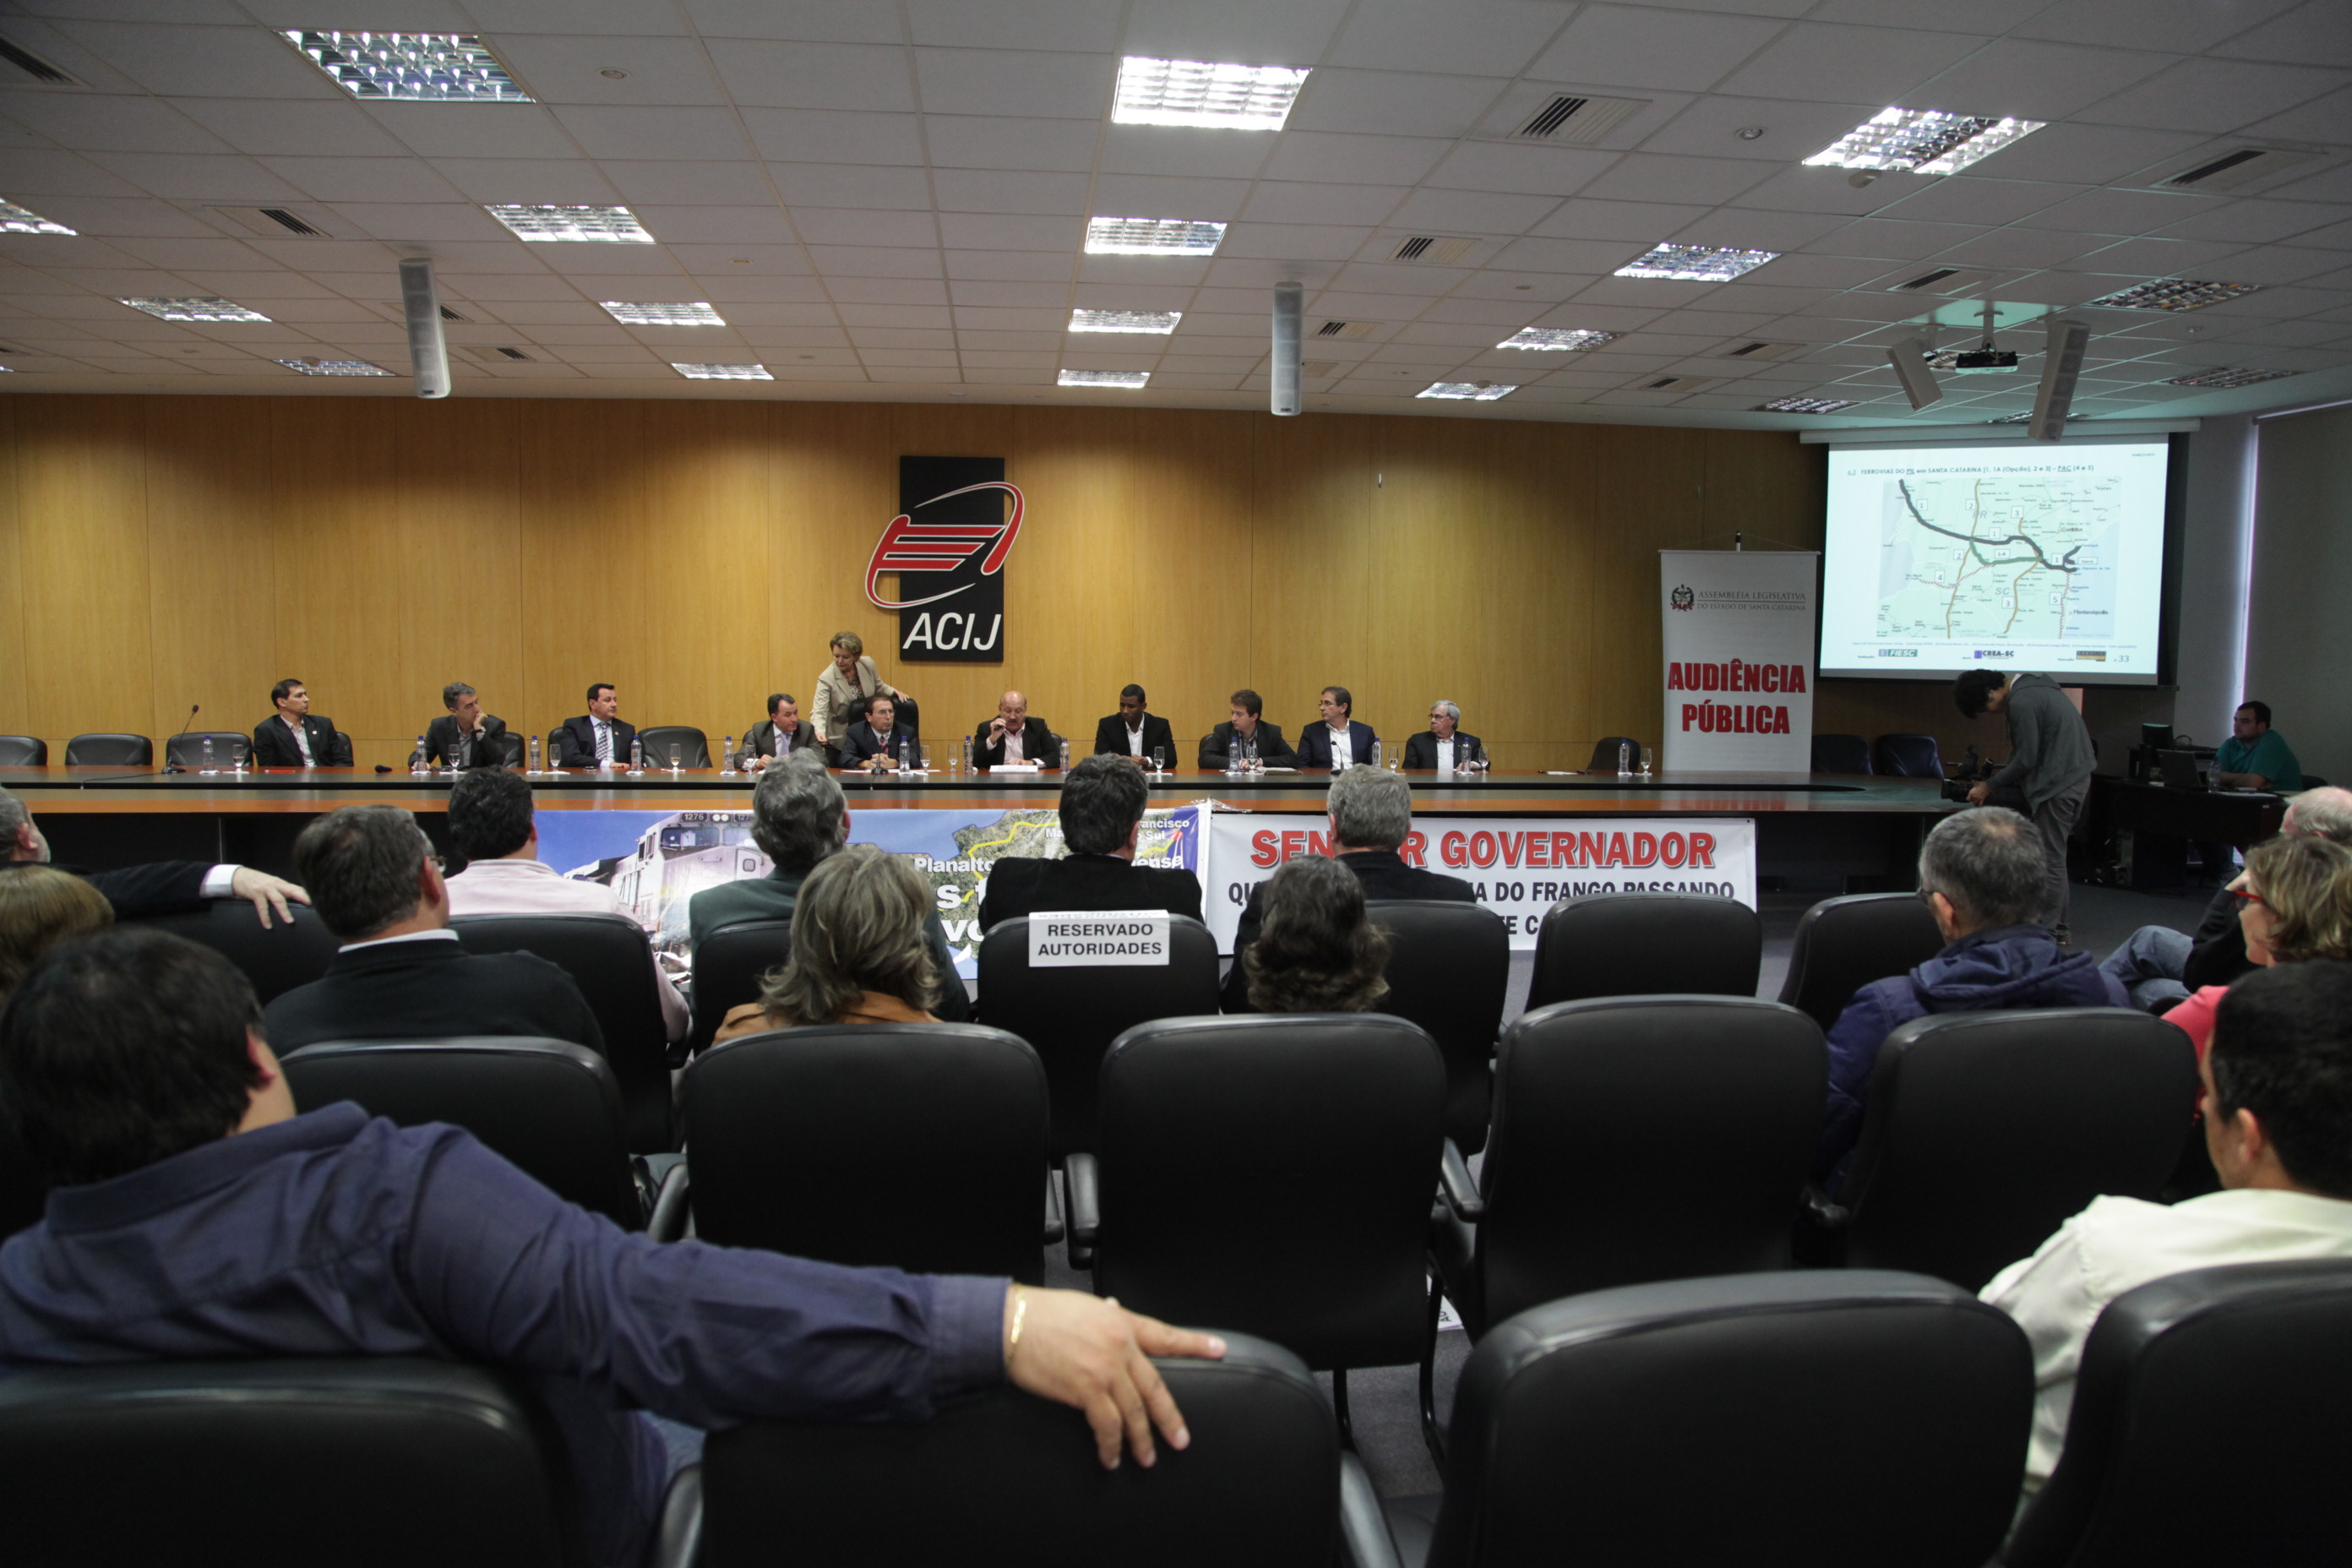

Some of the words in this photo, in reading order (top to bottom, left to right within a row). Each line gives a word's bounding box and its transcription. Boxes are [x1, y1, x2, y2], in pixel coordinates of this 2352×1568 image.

[1752, 591, 1806, 601] LEGISLATIVA
[1995, 586, 2011, 596] SC
[901, 612, 1002, 651] ACIJ
[1668, 658, 1806, 693] AUDIÊNCIA
[1682, 699, 1790, 734] PÚBLICA
[1137, 819, 1190, 829] rancisco
[1145, 830, 1166, 841] Sul
[1440, 830, 1715, 868] GOVERNADOR
[1494, 882, 1525, 902] DO
[1532, 881, 1616, 902] FRANGO
[1623, 881, 1734, 898] PASSANDO
[1048, 923, 1154, 937] RESERVADO
[1037, 942, 1162, 956] AUTORIDADES
